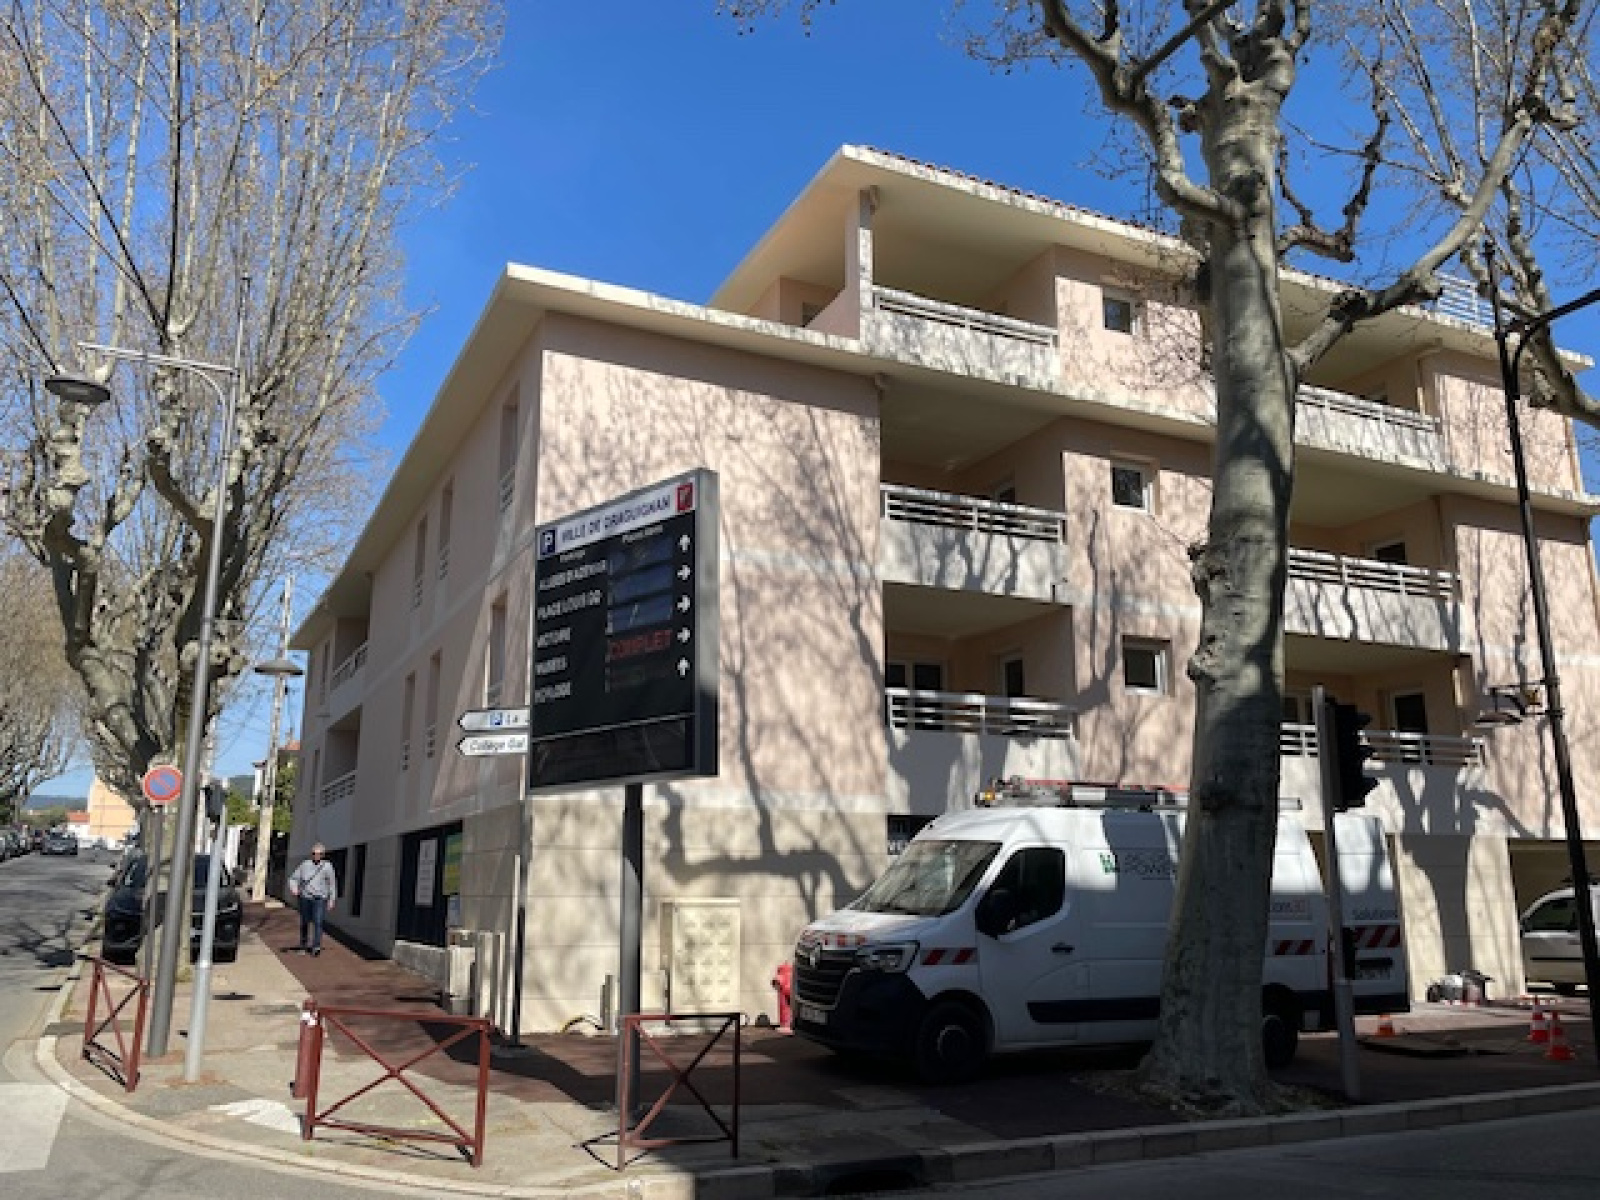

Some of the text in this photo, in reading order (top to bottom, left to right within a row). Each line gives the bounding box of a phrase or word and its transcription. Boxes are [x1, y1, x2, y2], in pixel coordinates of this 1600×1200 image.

[561, 524, 586, 543] VILLE
[589, 519, 601, 534] DE
[604, 494, 671, 529] DRAGUIGNAN
[609, 629, 673, 660] COMPLET
